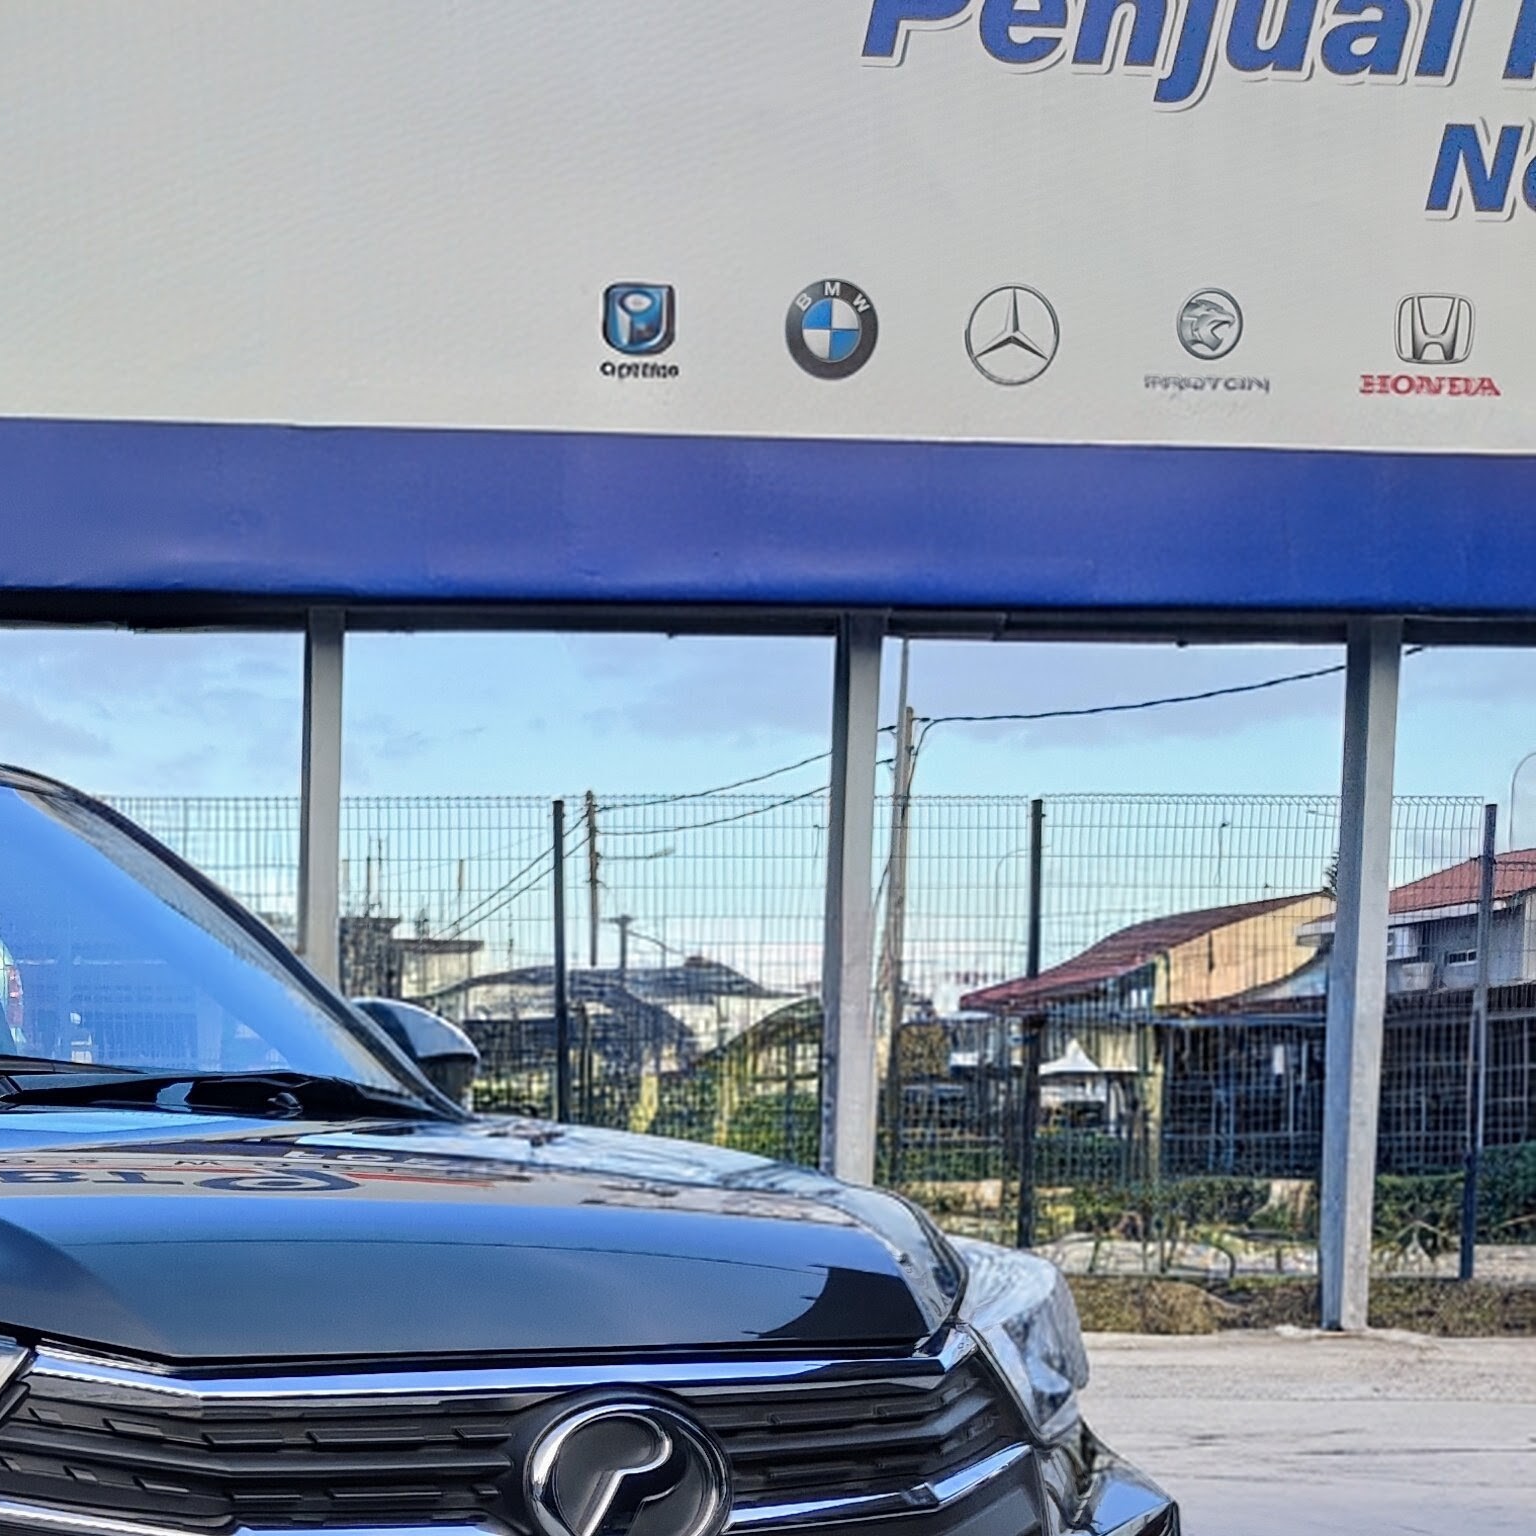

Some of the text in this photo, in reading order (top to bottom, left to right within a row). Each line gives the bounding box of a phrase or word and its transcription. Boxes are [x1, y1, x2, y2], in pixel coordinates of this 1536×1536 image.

[1424, 123, 1536, 213] N
[795, 281, 871, 313] BMW
[1359, 374, 1502, 397] HONDA
